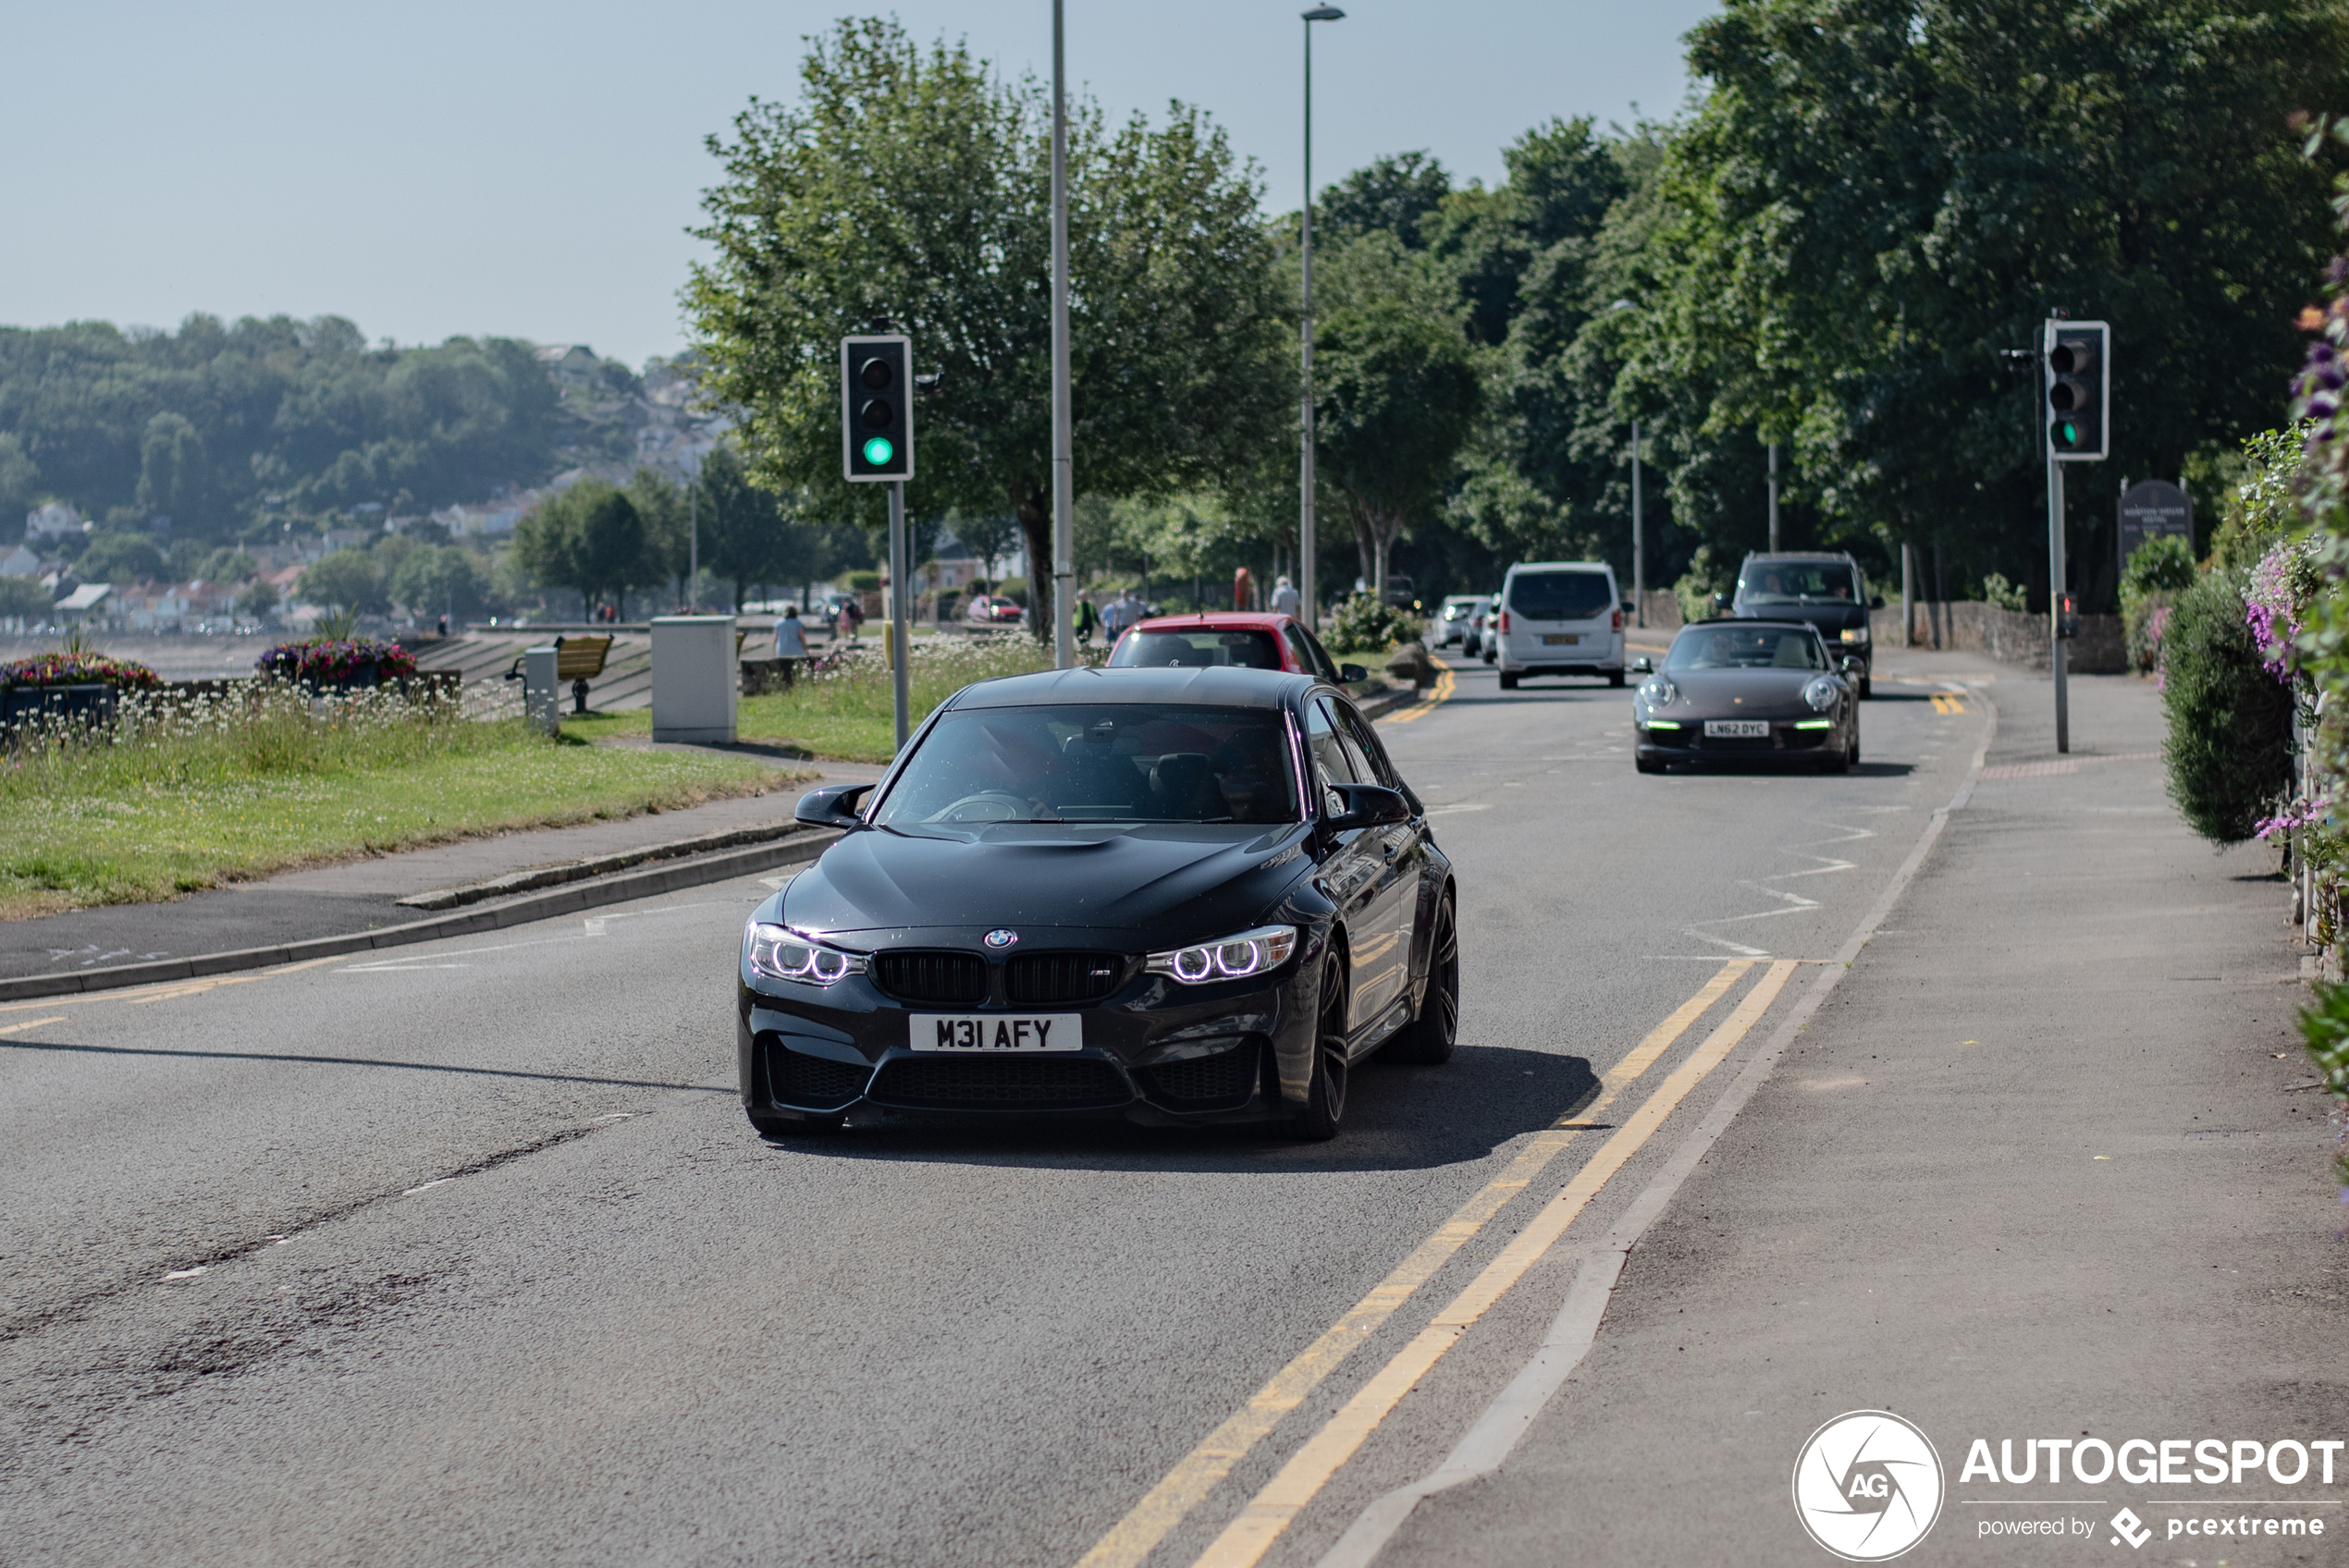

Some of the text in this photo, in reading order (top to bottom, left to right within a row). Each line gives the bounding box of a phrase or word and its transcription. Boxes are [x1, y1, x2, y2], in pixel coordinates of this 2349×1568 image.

[1710, 724, 1764, 734] LN62 DYC
[937, 1020, 1052, 1047] M31 AFY
